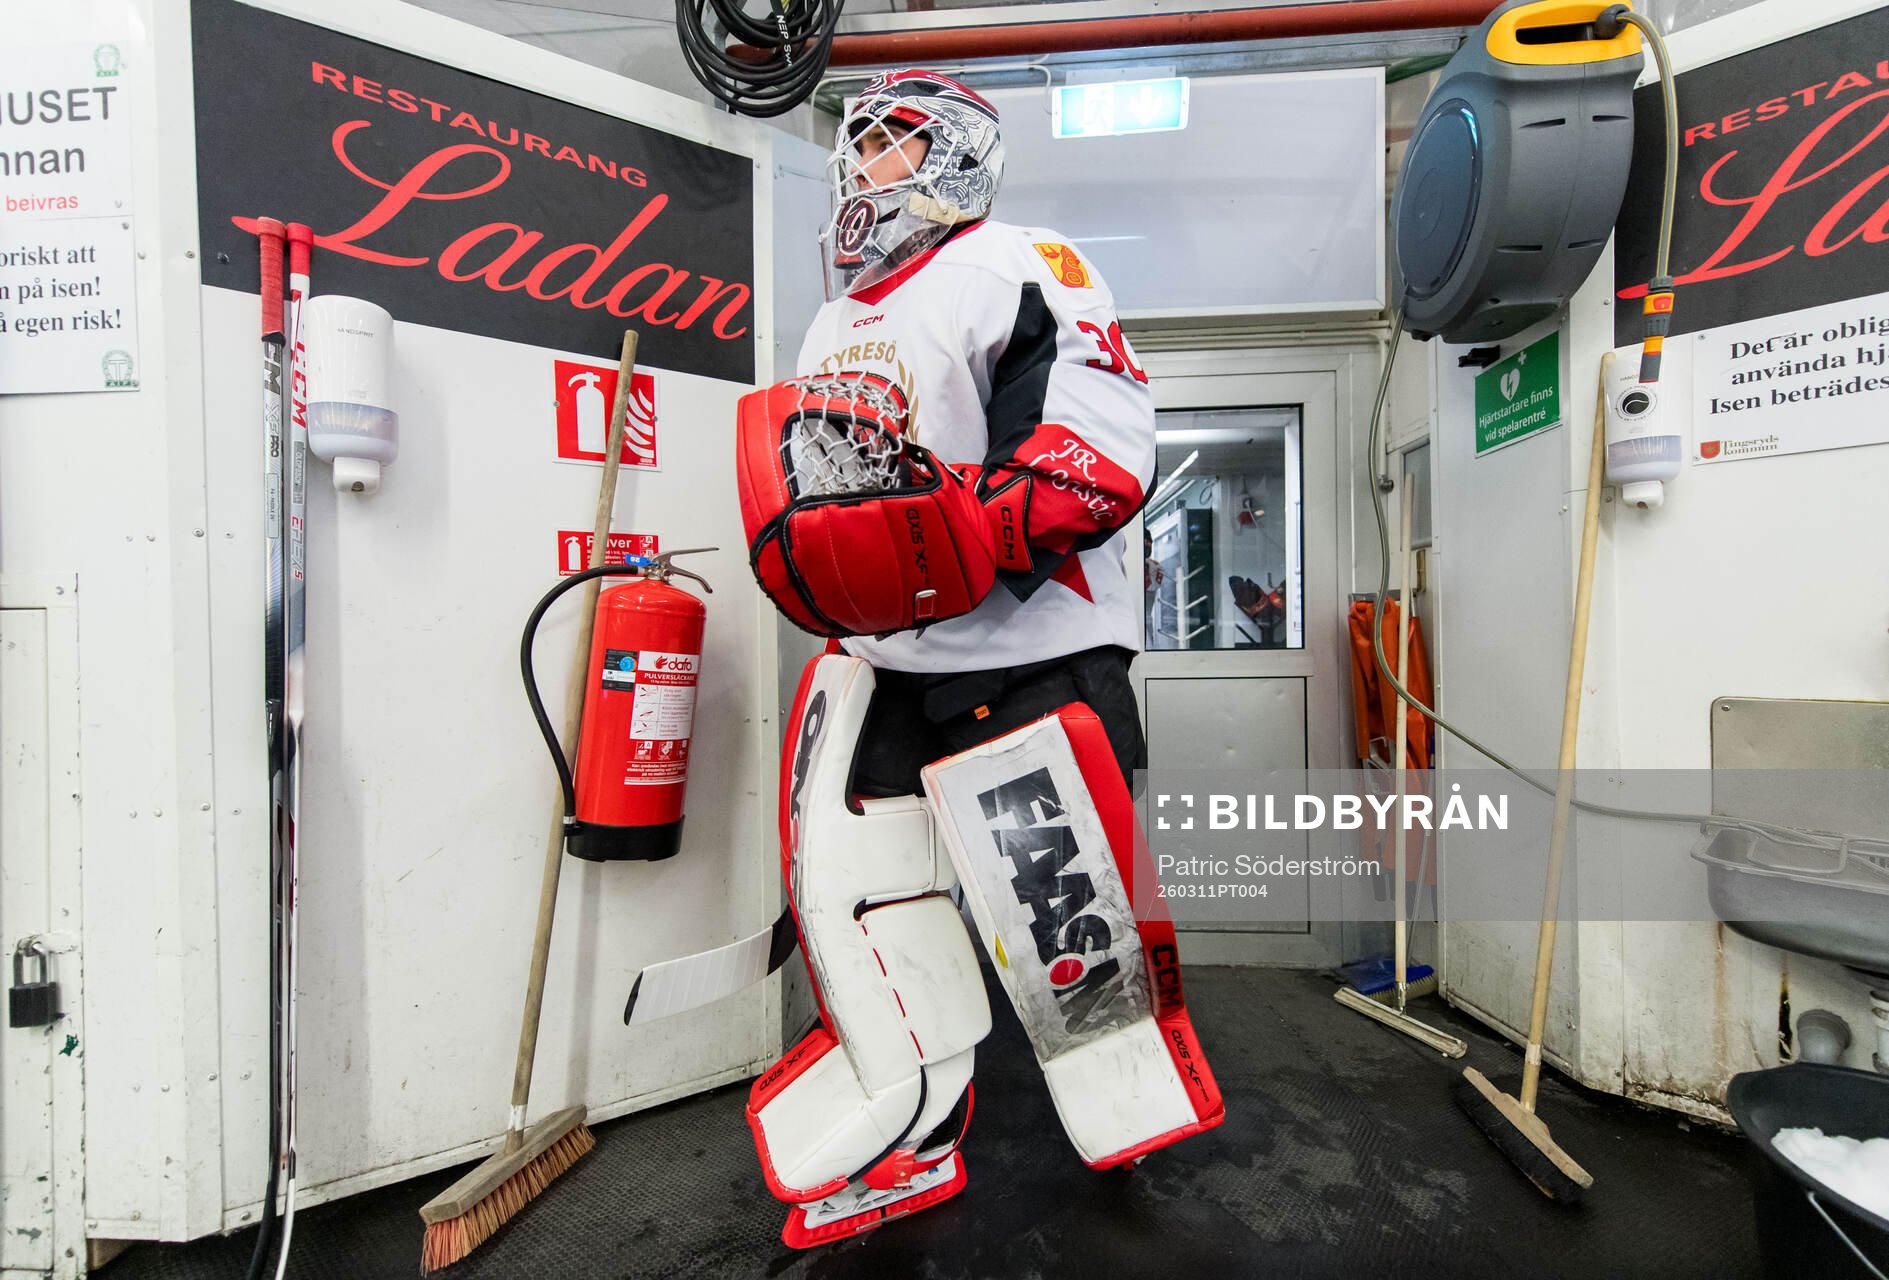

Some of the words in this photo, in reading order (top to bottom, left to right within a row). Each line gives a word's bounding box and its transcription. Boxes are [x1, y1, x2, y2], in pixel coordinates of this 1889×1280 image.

[776, 15, 789, 39] NEP
[0, 86, 117, 125] USET
[311, 61, 648, 188] RESTAURANG
[5, 193, 79, 212] beivras
[231, 120, 752, 341] Ladan
[67, 245, 96, 264] att
[18, 277, 44, 304] på
[51, 276, 101, 298] isen!
[15, 317, 64, 337] egen
[72, 309, 121, 331] risk!
[853, 314, 884, 328] CCM
[820, 339, 896, 376] TYRESÖ
[1077, 320, 1149, 386] 30
[1730, 335, 1776, 360] Det
[1731, 353, 1846, 386] använda
[1857, 343, 1889, 366] hj
[1479, 397, 1529, 430] Hjärtstartare
[1530, 385, 1553, 405] finns
[1710, 397, 1762, 415] Isen
[1770, 375, 1889, 406] beträdes
[1484, 425, 1497, 443] vid
[1497, 406, 1547, 438] spelarentré
[271, 434, 280, 458] PRO
[1720, 434, 1780, 450] Tingsryds
[1723, 442, 1778, 457] kommun
[1050, 438, 1097, 481] JR
[586, 535, 632, 549] Plver
[999, 506, 1016, 562] CCM
[668, 657, 692, 671] dafo
[1152, 943, 1180, 1008] CCM
